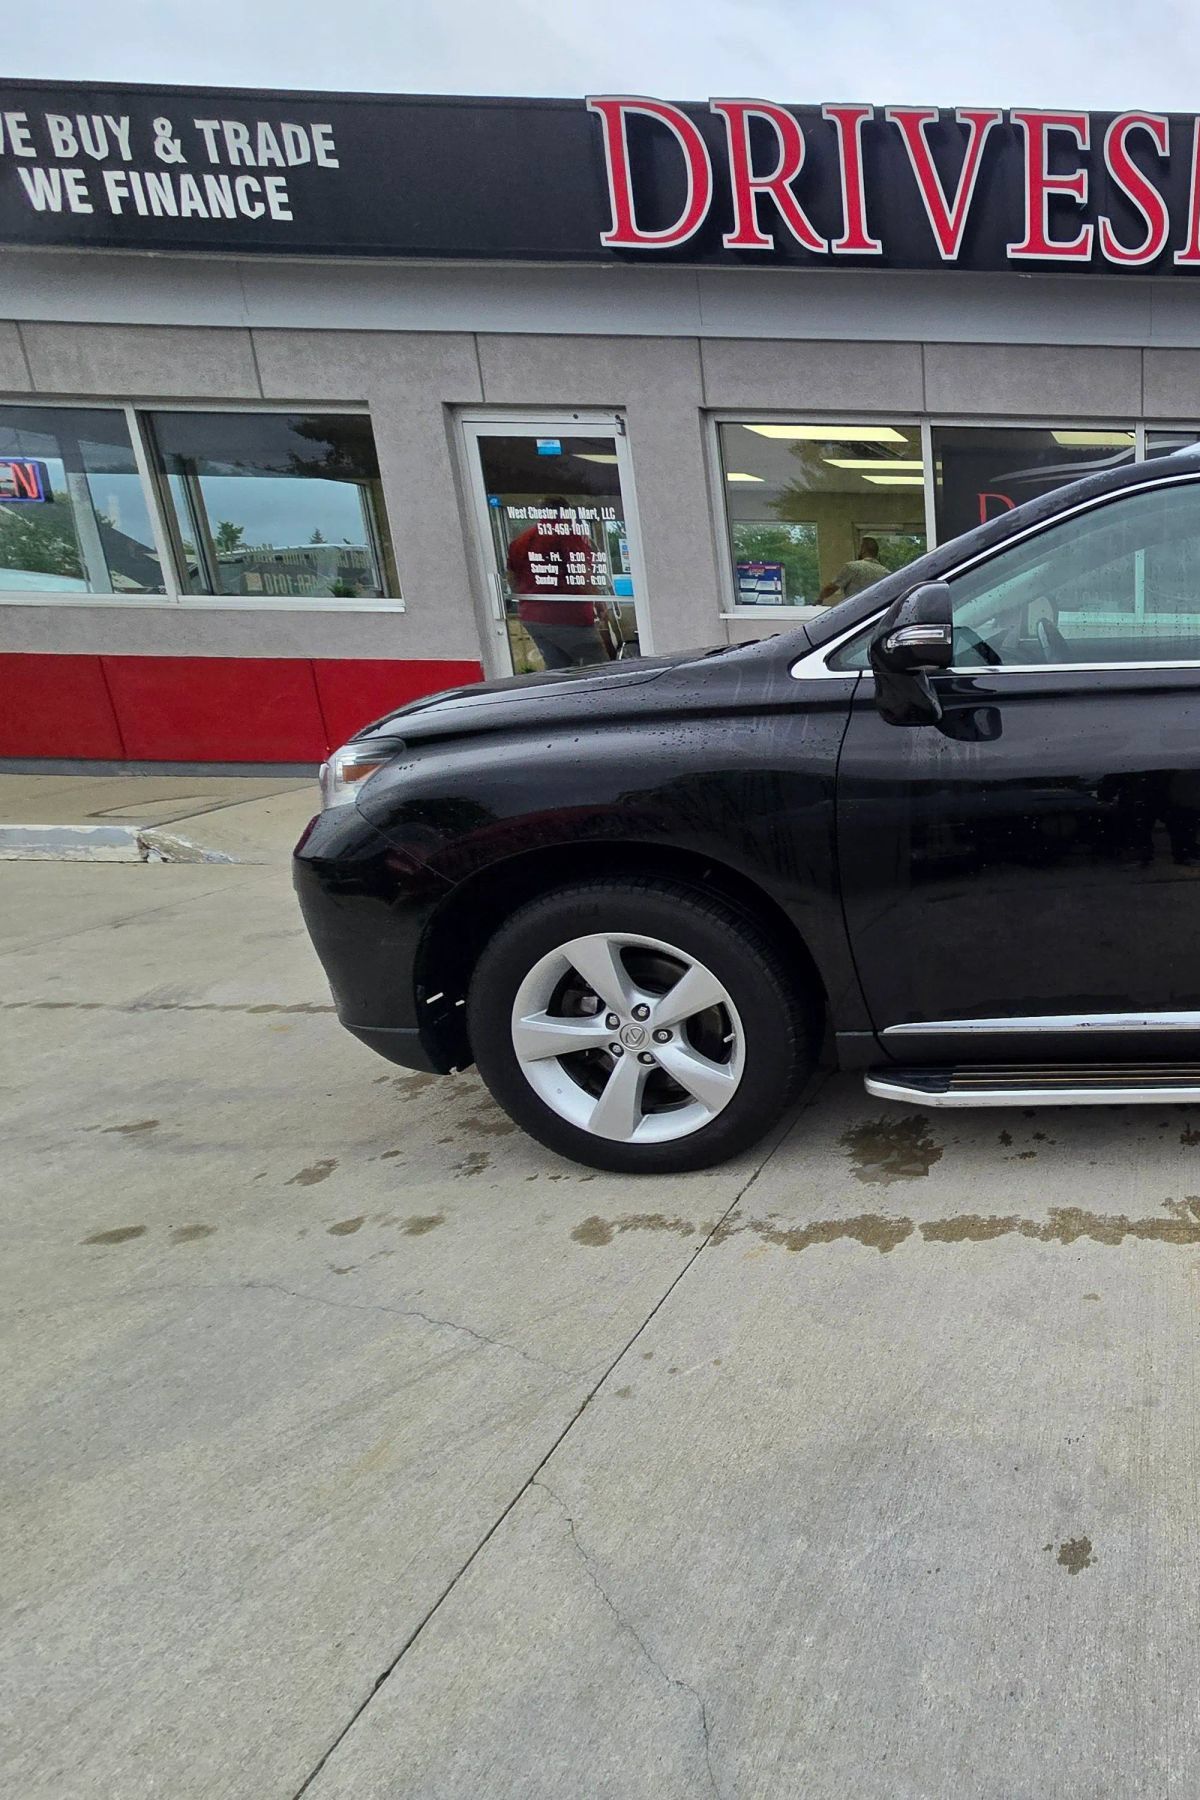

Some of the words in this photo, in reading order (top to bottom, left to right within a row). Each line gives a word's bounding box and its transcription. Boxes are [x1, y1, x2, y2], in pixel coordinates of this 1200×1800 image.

[0, 111, 37, 158] E
[44, 113, 131, 161] BUY
[153, 116, 187, 164] &
[194, 118, 340, 169] TRADE
[17, 167, 94, 214] WE
[102, 171, 294, 221] FINANCE
[506, 506, 527, 519] West
[528, 506, 558, 520] Chester
[560, 506, 577, 520] Auto
[578, 506, 600, 521] Mart,
[601, 507, 616, 520] LLC
[569, 551, 585, 562] 9:00
[591, 551, 607, 562] 7:00
[531, 563, 559, 574] Saturday
[566, 563, 586, 574] 10:00
[592, 563, 607, 574] 7:00
[535, 575, 558, 586] Sunday
[565, 575, 585, 585] 10:00
[590, 575, 607, 585] 6:00
